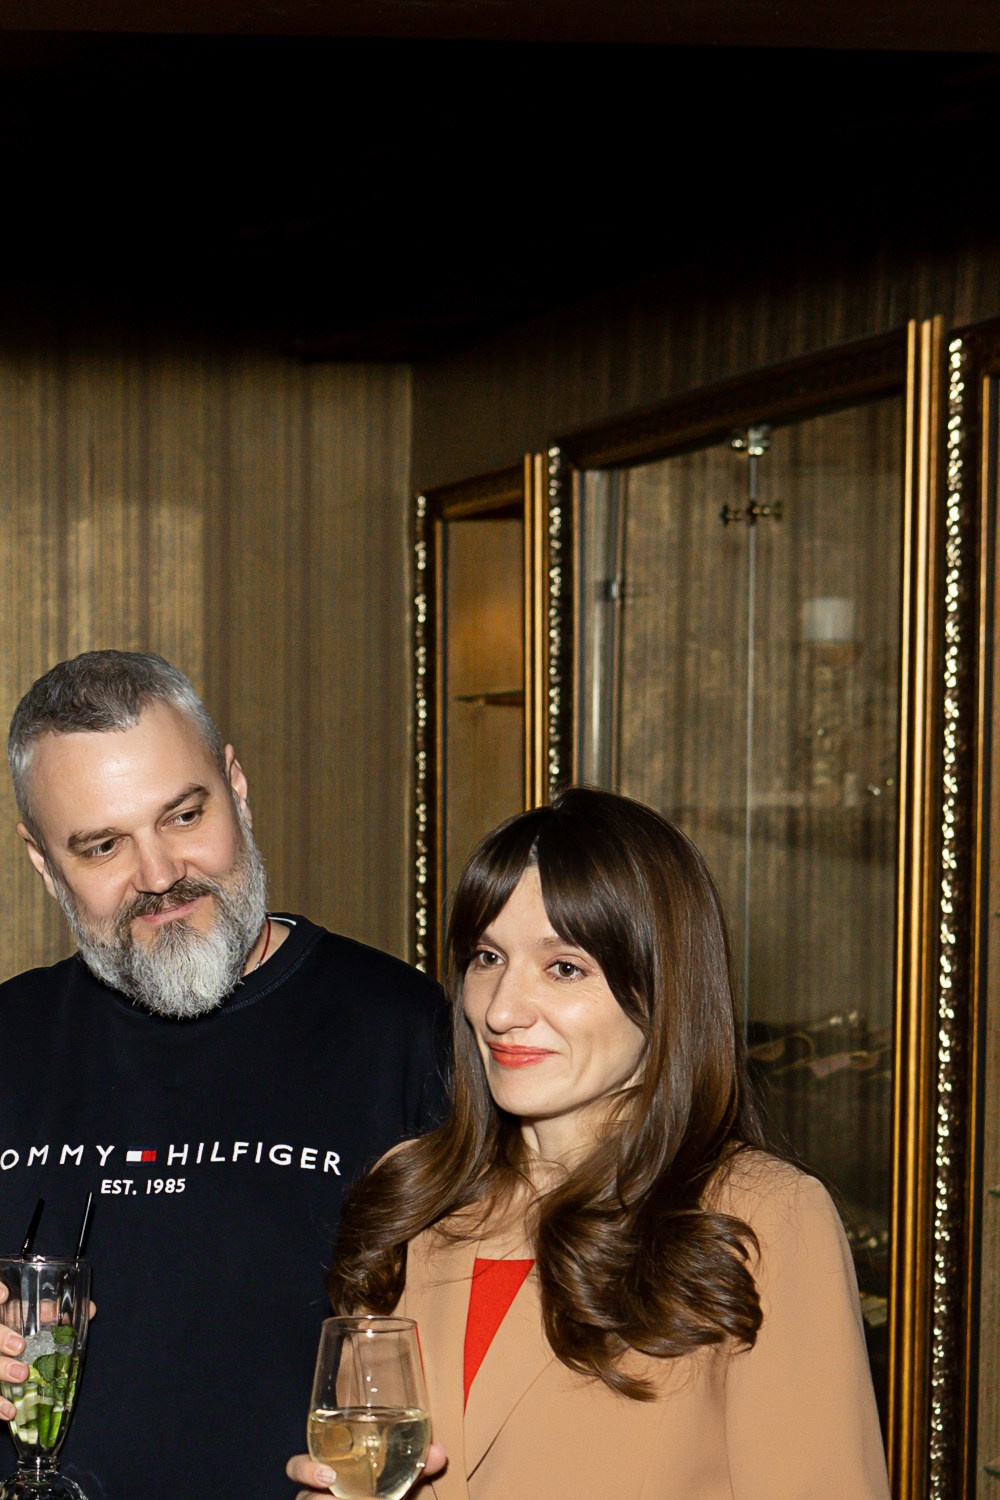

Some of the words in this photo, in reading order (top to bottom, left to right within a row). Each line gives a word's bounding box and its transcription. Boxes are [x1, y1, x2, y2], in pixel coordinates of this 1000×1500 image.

[167, 1141, 342, 1176] HILFIGER
[100, 1179, 137, 1196] EST.
[146, 1178, 186, 1195] 1985
